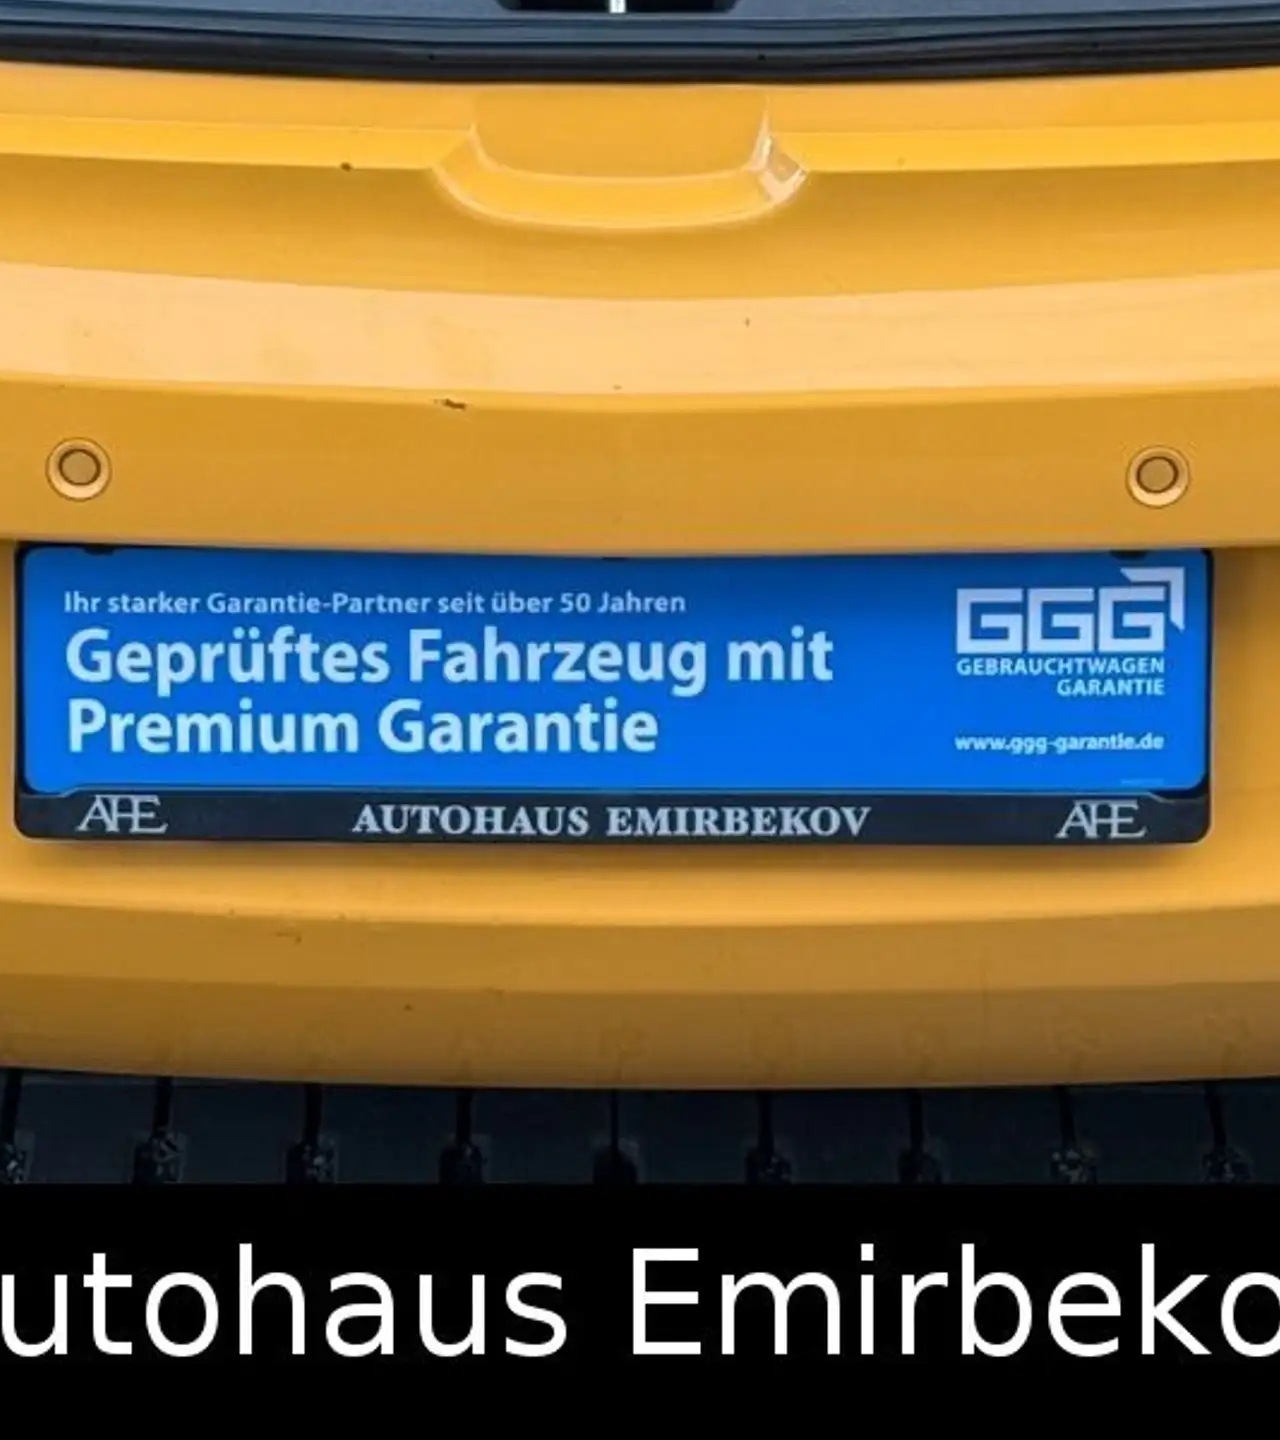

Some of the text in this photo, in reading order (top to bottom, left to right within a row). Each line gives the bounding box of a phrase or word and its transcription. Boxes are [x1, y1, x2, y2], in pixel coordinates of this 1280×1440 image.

[64, 591, 686, 614] Ihr starker Garantie-Partner seit über 50 Jahren
[956, 586, 1166, 654] GGG
[65, 625, 833, 697] Geprüftes Fahrzeug mit
[956, 658, 1165, 676] GEBRAUCHTWAGEN
[1057, 679, 1165, 696] GARANTIE
[69, 697, 658, 753] Premium Garantie
[955, 733, 1164, 755] www.ggg-garantie.de
[352, 804, 872, 836] AUTOHAUS EMIRBEKOV
